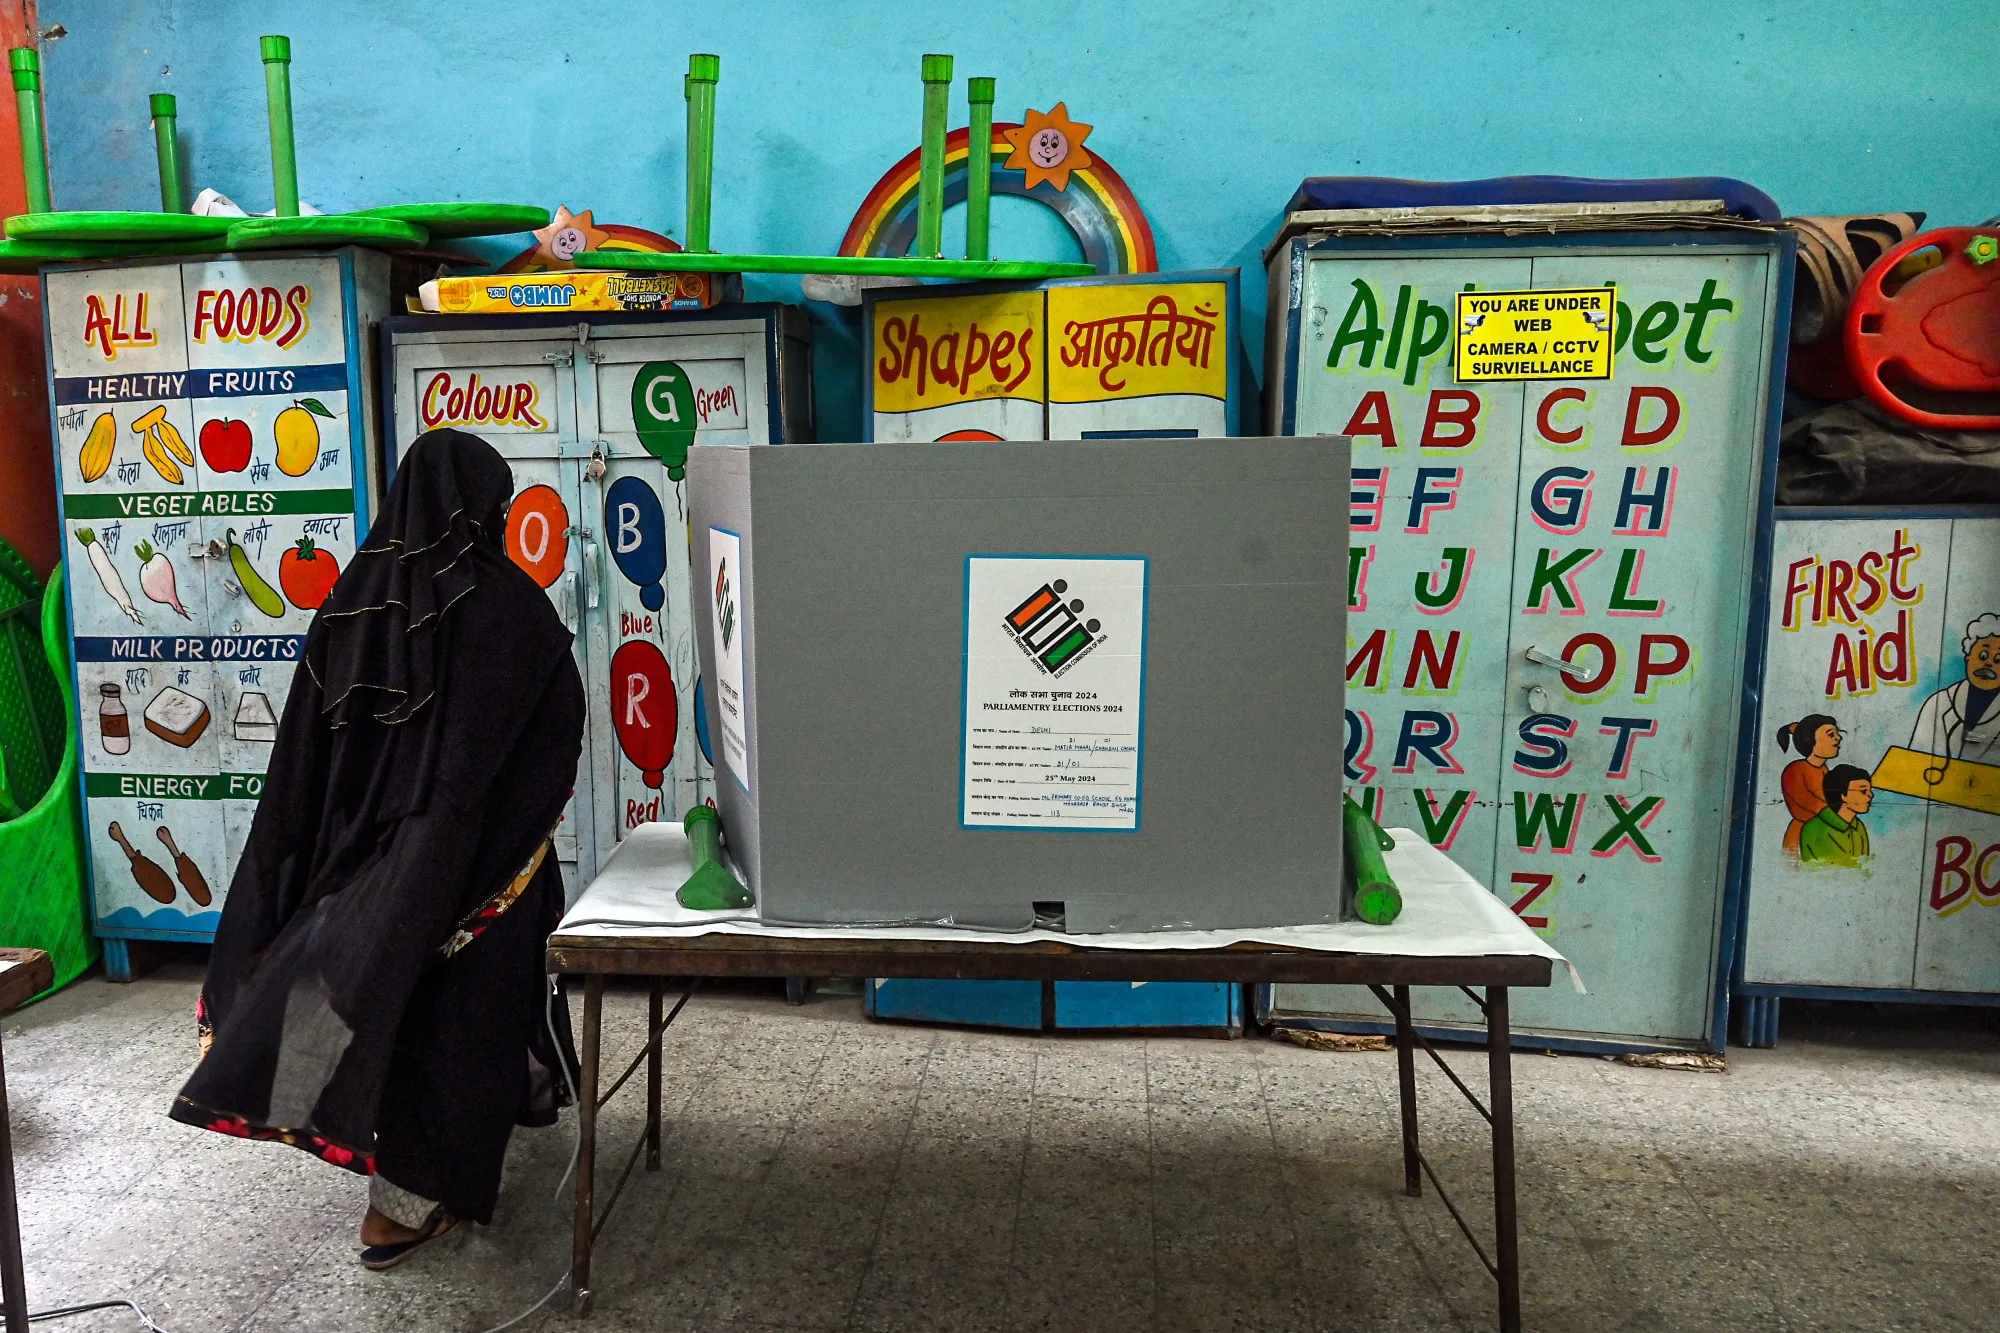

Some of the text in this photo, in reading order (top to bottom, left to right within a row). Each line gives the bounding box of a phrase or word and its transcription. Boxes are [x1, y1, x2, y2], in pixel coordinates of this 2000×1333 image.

[509, 284, 576, 307] JUMBO
[607, 276, 677, 296] BASKETBALL
[638, 294, 662, 303] WONDER
[1470, 297, 1601, 313] YOU ARE UNDER
[84, 285, 311, 360] ALL FOODS
[1514, 318, 1552, 332] WEB
[878, 313, 1034, 396] Shapes
[1468, 342, 1538, 355] CAMERA
[1553, 340, 1599, 353] CCTV
[1472, 360, 1593, 375] SURVIELLANCE
[88, 370, 296, 399] HEALTHY FRUITS
[645, 376, 680, 423] G
[696, 384, 738, 423] Green
[1342, 386, 1682, 450] A B C D
[1405, 467, 1460, 532] F
[1531, 466, 1592, 533] G
[1613, 466, 1675, 535] H
[519, 511, 549, 564] O
[617, 502, 643, 554] B
[1414, 547, 1472, 613] J
[1525, 547, 1600, 614] K
[1608, 547, 1662, 616] L
[621, 613, 653, 638] Blue
[111, 639, 164, 659] MILK
[1402, 629, 1464, 694] N
[1560, 632, 1620, 702] O
[1633, 633, 1694, 702] P
[625, 673, 652, 729] R
[983, 703, 1123, 713] PARLIAMENTRY ELECTIONS 2024
[1009, 688, 1097, 702] लोक सभा चुनाव 2024
[1392, 710, 1460, 774] R
[1513, 712, 1576, 778] S
[1600, 716, 1657, 778] T
[121, 775, 265, 797] ENERGY FO
[1060, 775, 1076, 783] May
[626, 796, 660, 828] Red
[1414, 788, 1475, 850] V
[1513, 790, 1585, 853] W
[1590, 794, 1665, 862] X
